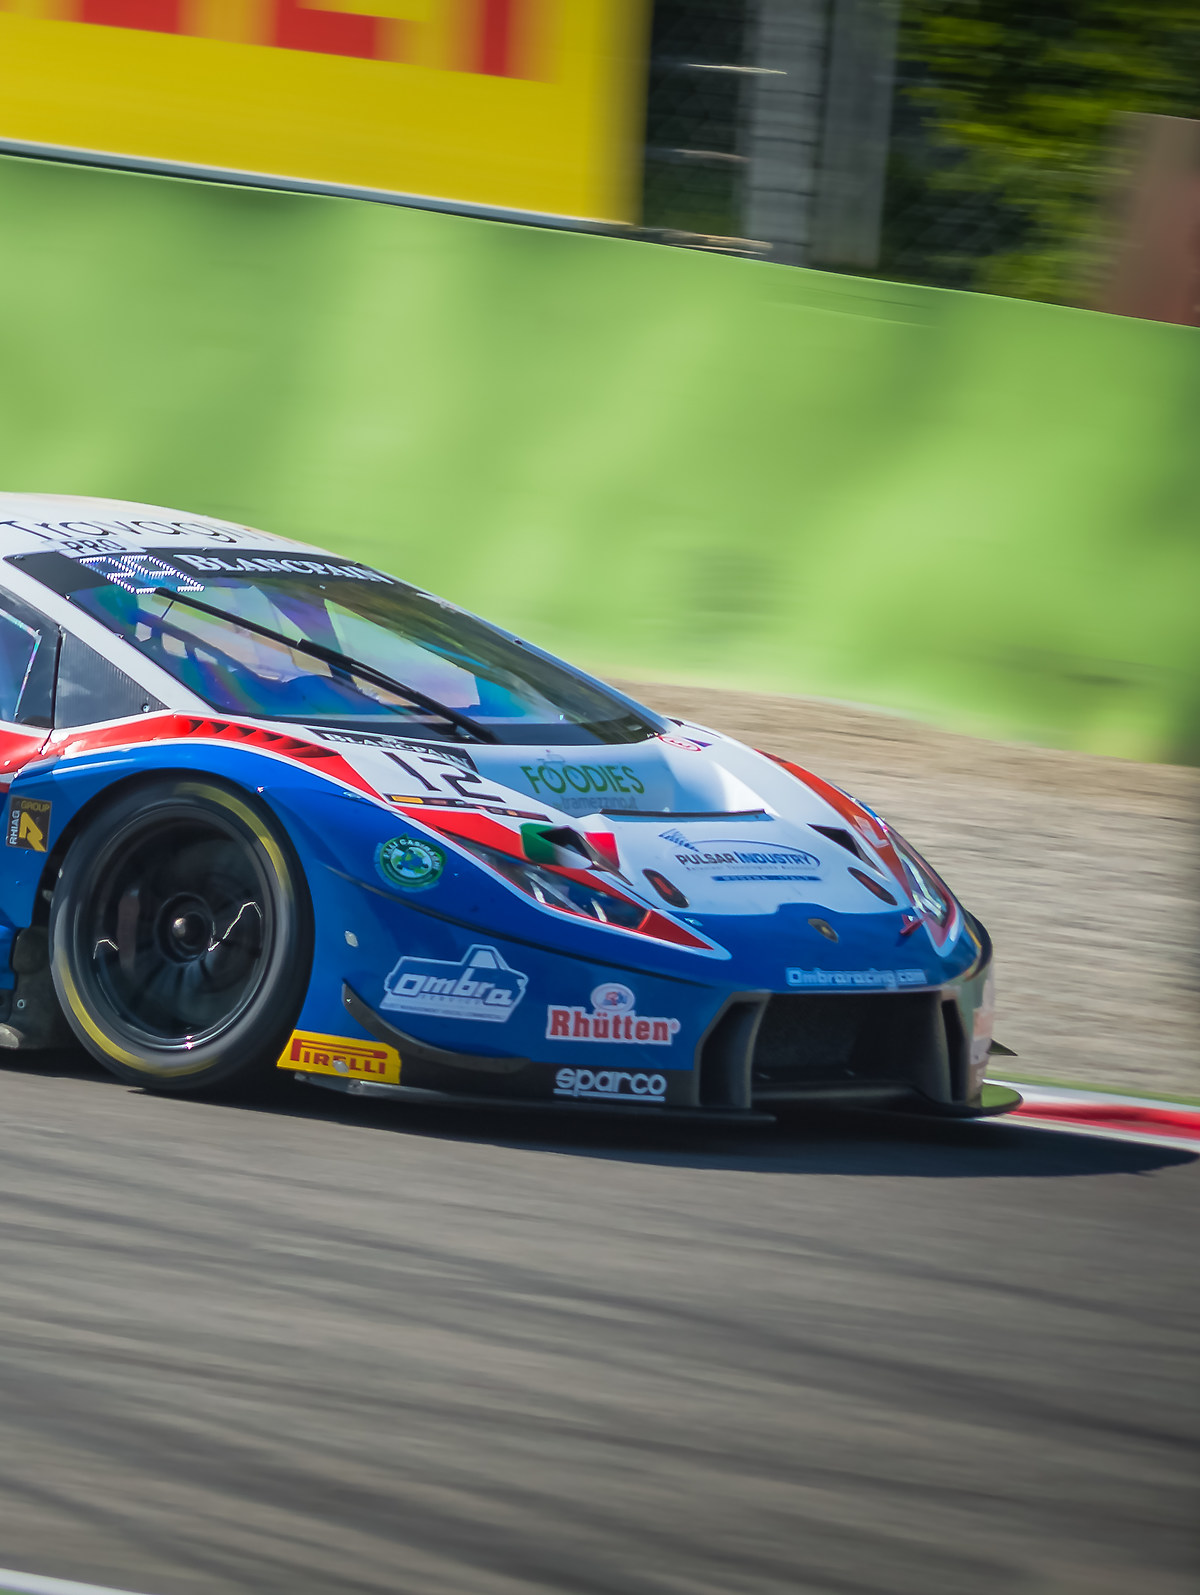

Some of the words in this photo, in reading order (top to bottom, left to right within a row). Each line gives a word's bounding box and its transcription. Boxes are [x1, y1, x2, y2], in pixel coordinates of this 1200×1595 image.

[60, 538, 128, 555] PRO
[172, 553, 395, 585] BLANCPAIN
[380, 750, 507, 803] 12
[519, 765, 645, 794] FOODIES
[21, 800, 50, 812] GROUP
[9, 810, 21, 845] RHIAG
[391, 967, 514, 1006] ombra
[555, 1067, 667, 1097] sparco
